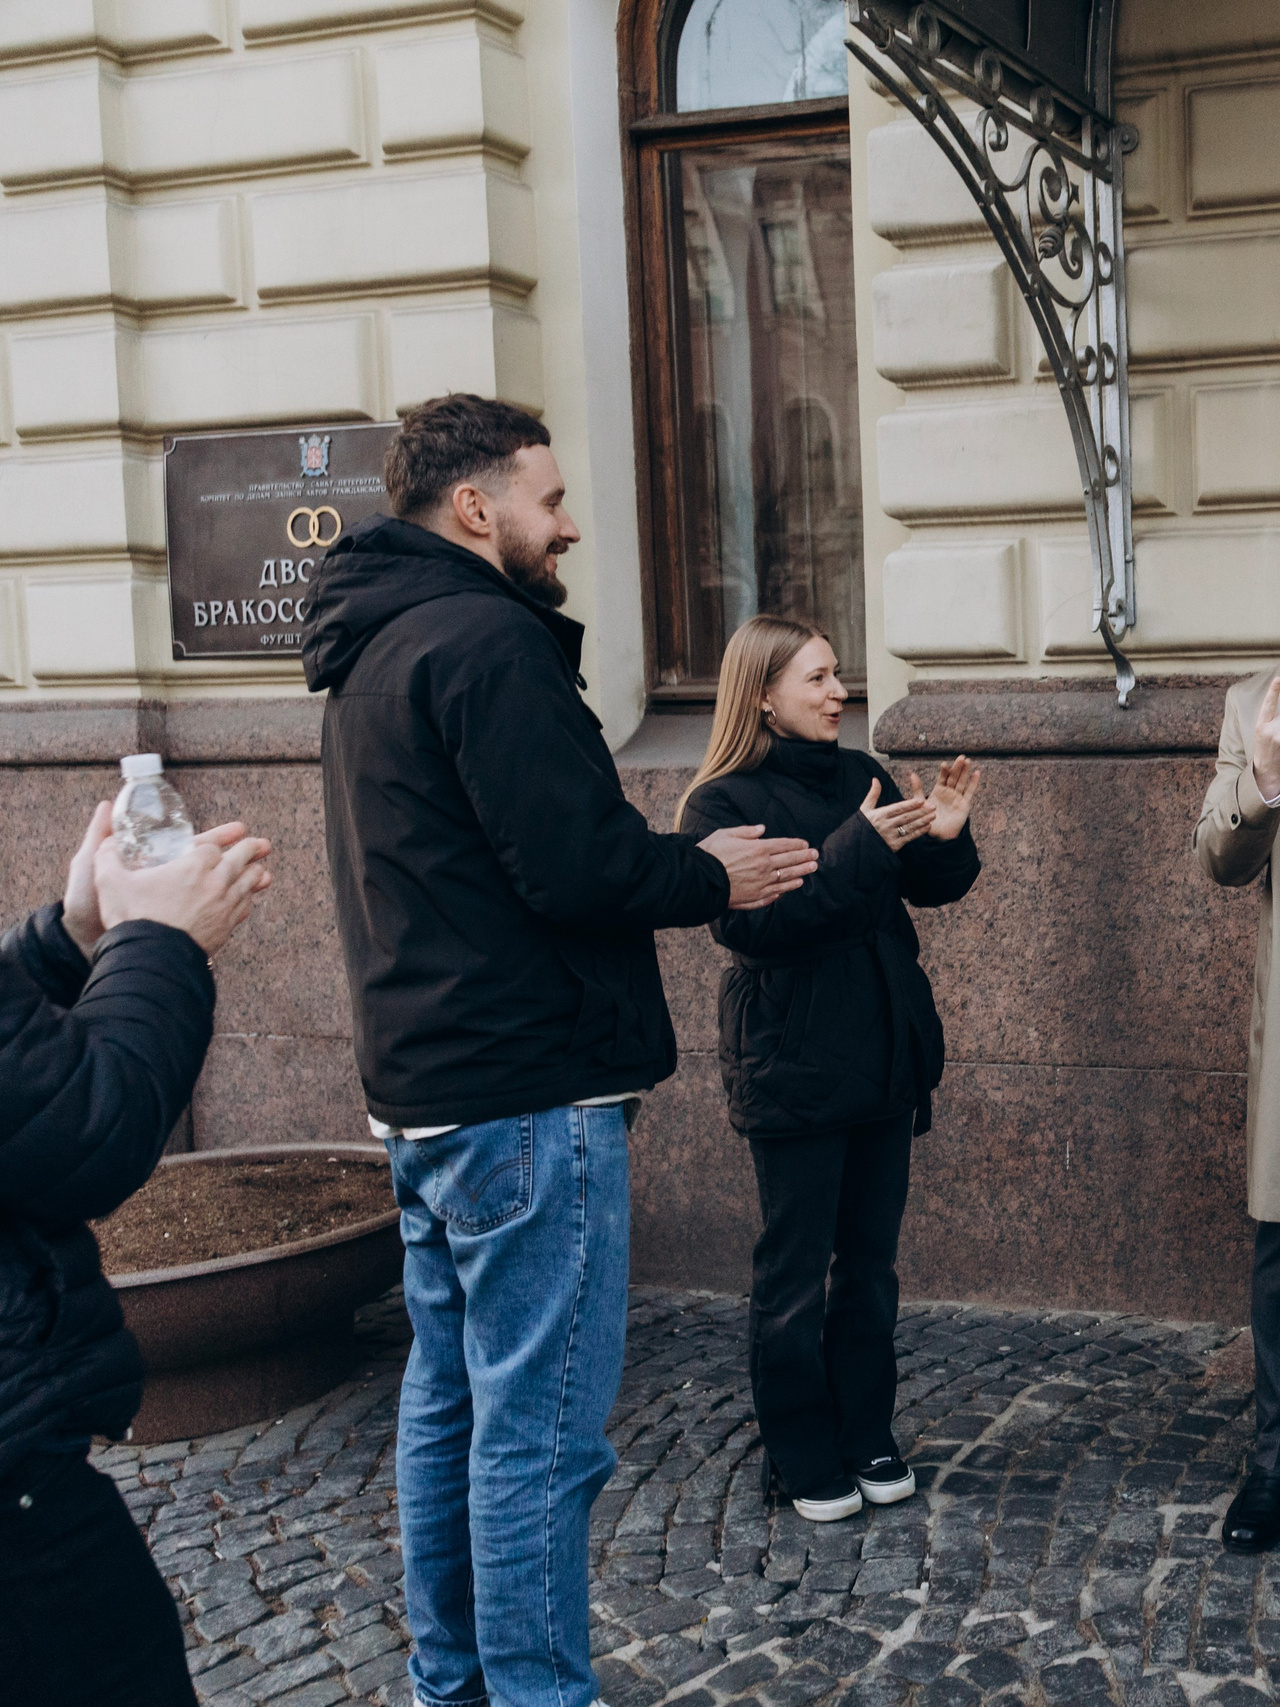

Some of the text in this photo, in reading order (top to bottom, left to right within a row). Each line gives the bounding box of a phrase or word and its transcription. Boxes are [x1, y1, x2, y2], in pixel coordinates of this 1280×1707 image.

[249, 482, 305, 492] ПРАВИТЕЛЬСТВО
[234, 493, 245, 501] ПО
[306, 488, 328, 497] АКТОВ
[259, 557, 322, 589] ДВО
[260, 633, 302, 645] ФУРШТ
